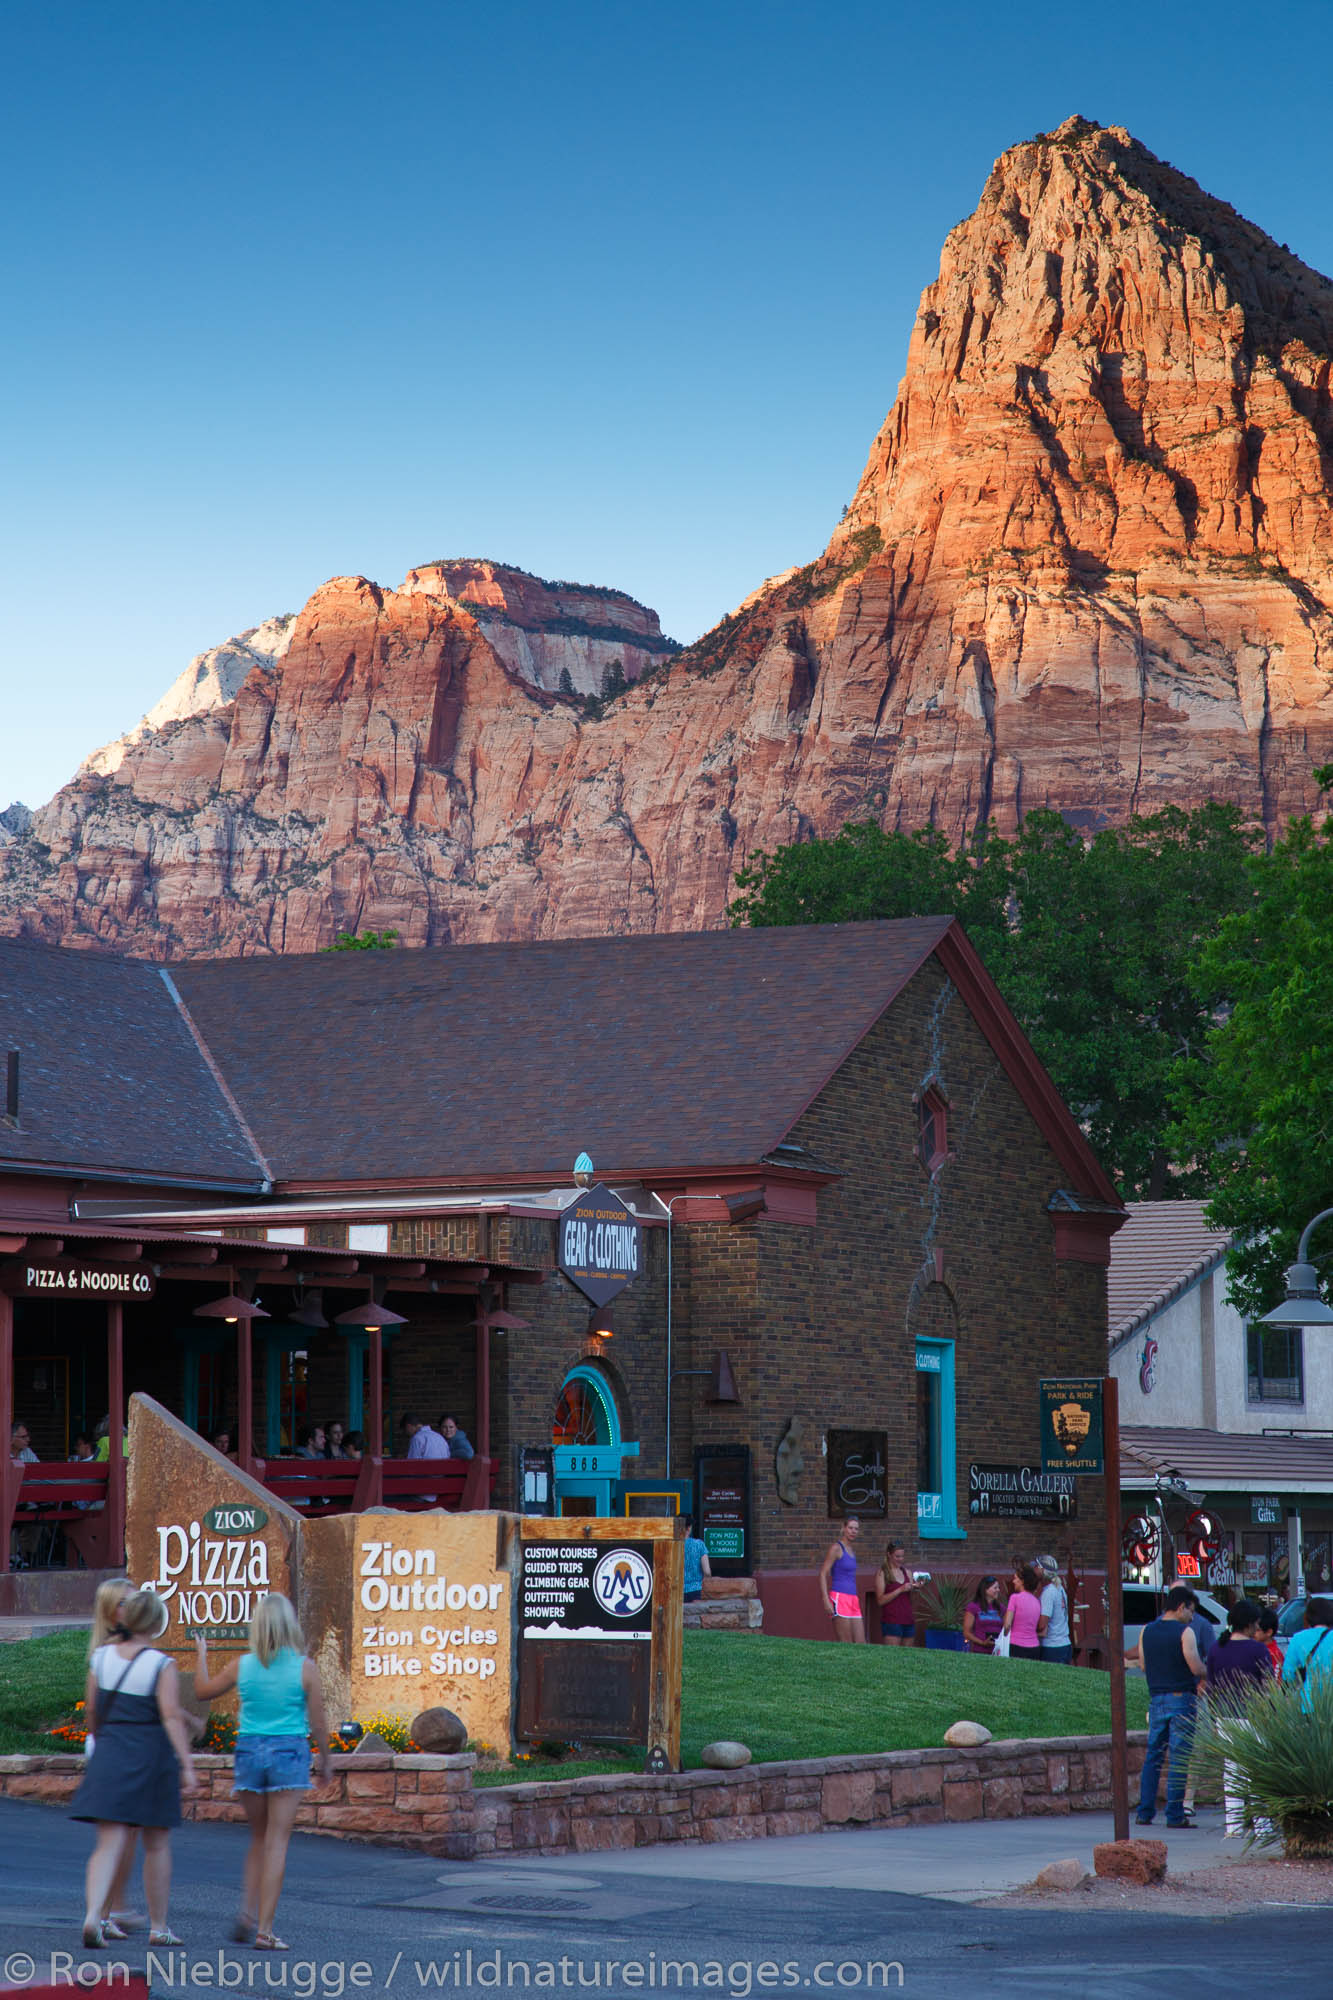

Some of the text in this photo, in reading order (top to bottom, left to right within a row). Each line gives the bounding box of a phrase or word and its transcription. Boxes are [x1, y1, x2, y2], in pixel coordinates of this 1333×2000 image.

[575, 1207, 627, 1221] ZION OUTDOOR
[564, 1220, 637, 1272] GEAR & CLOTHING
[27, 1267, 151, 1292] PIZZA & NOODLE CO.
[970, 1464, 1075, 1493] SORELLA GALLERY
[992, 1494, 1053, 1505] LOCATED DOWNSTAIRS
[214, 1510, 256, 1529] ZION
[1257, 1507, 1275, 1522] Gifts
[360, 1541, 436, 1576] Zion
[524, 1547, 598, 1559] CUSTOM COURSES
[524, 1562, 583, 1573] GUIDED TRIPS
[524, 1577, 590, 1588] CLIMBING GEAR
[360, 1576, 504, 1612] Outdoor
[524, 1592, 575, 1603] OUTFITTING
[177, 1589, 269, 1625] NOODL
[524, 1606, 565, 1618] SHOWERS
[362, 1624, 498, 1650] Zion Cycles
[364, 1652, 496, 1680] Bike Shop
